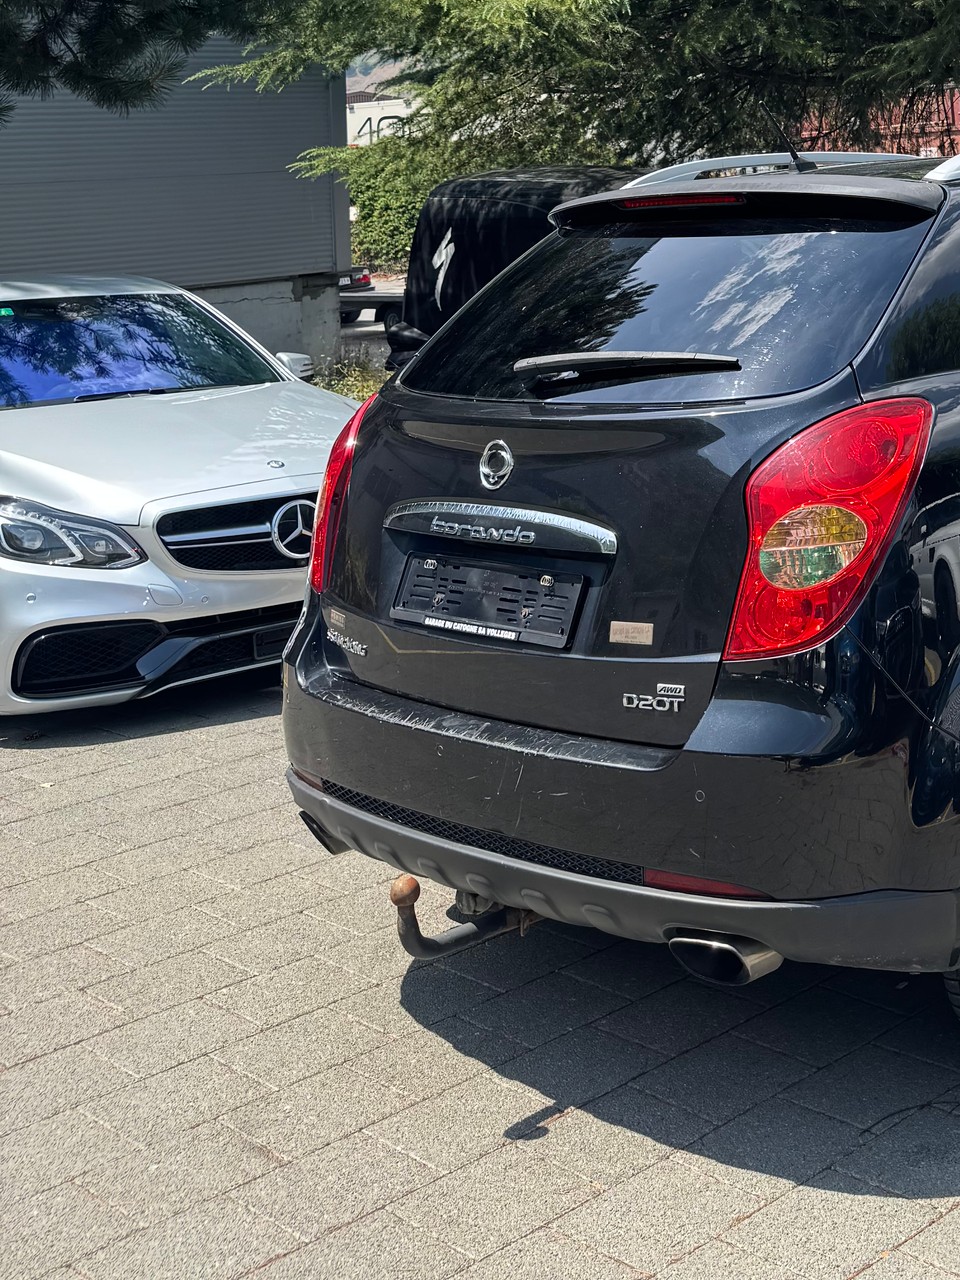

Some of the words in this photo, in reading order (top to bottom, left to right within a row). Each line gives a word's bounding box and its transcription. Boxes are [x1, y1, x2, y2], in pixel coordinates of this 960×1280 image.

[425, 617, 445, 627] GARAGE
[445, 621, 452, 629] DU
[453, 623, 478, 633] CATOGNE
[658, 685, 683, 695] AWD
[622, 693, 685, 713] D20T
